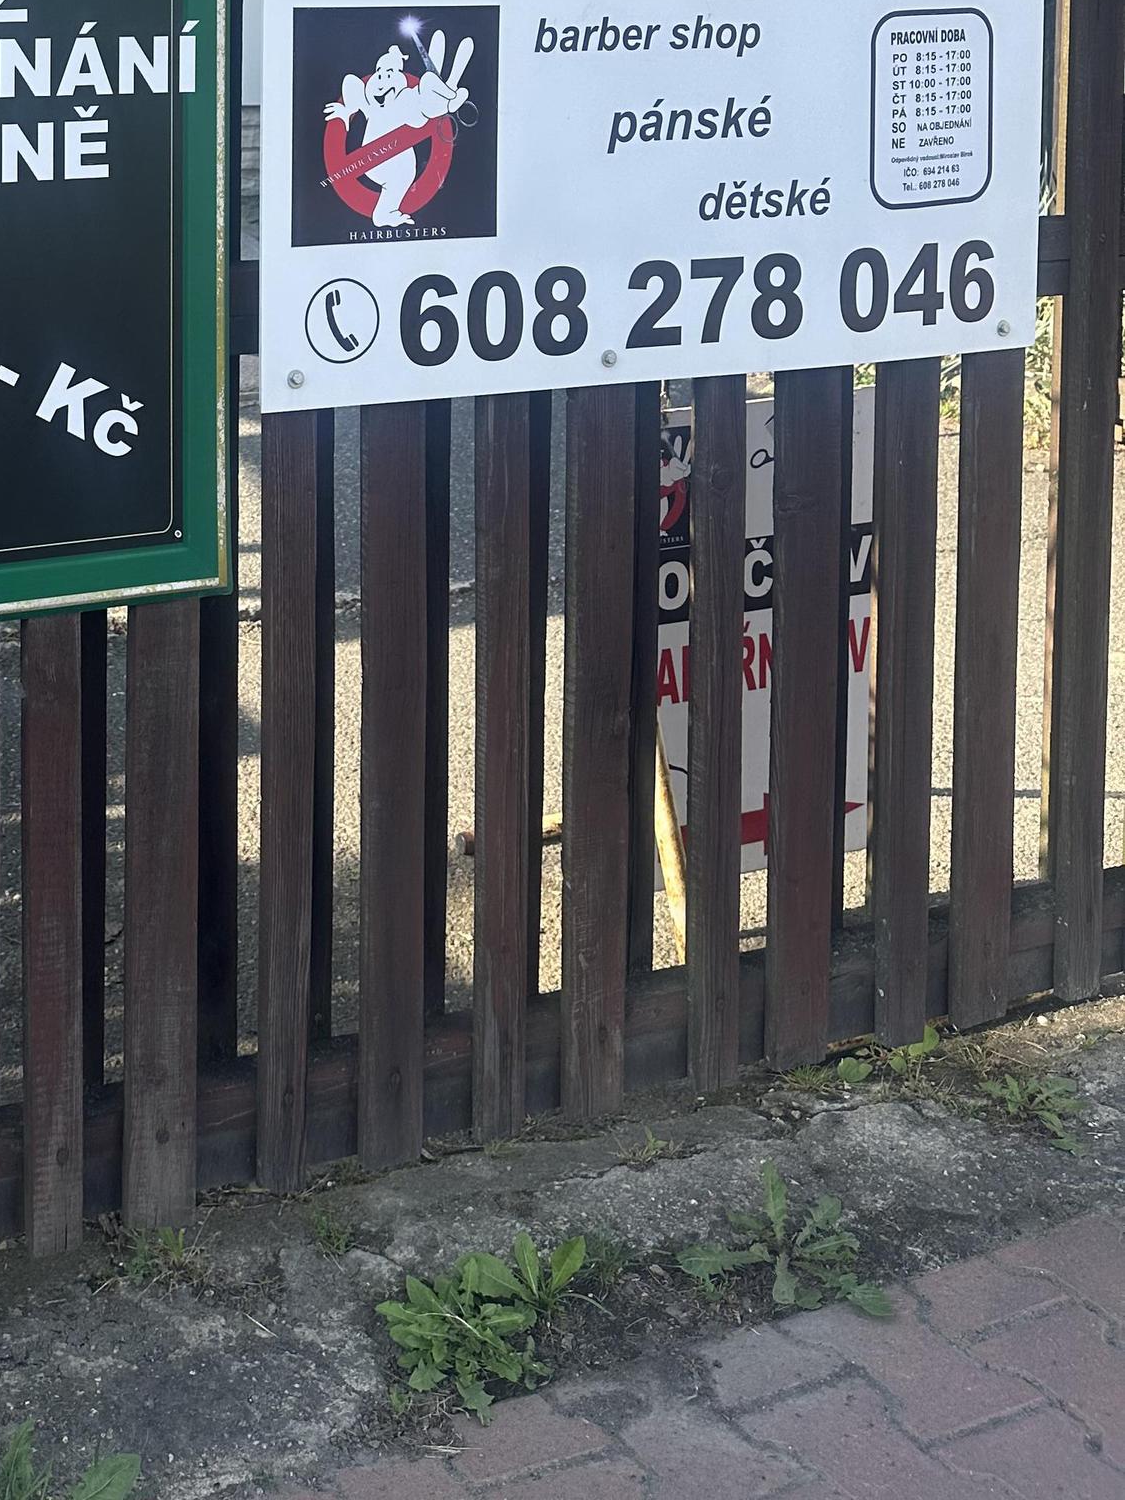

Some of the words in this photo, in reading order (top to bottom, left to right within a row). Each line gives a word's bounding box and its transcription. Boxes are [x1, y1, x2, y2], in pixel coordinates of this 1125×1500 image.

[534, 16, 661, 53] barber
[669, 15, 761, 57] shop
[891, 27, 938, 45] PRACOVNÍ
[940, 29, 966, 43] DOBA
[892, 53, 907, 63] PO
[916, 51, 937, 61] 8:15
[945, 49, 971, 60] 17:00
[892, 65, 907, 76] ÚT
[915, 64, 937, 75] 8:15
[945, 62, 971, 73] 17:00
[892, 80, 906, 91] ST
[909, 78, 936, 89] 10:00
[945, 76, 971, 87] 17:00
[892, 92, 906, 104] ČT
[915, 92, 937, 103] 8:15
[945, 89, 972, 100] 17:00
[892, 106, 907, 118] PÁ
[915, 106, 937, 117] 8:15
[945, 103, 971, 115] 17:00
[606, 95, 771, 154] pánské
[891, 122, 906, 133] SO
[917, 122, 928, 132] NA
[929, 117, 972, 131] OBJEDNÁNÍ
[891, 138, 905, 149] NE
[919, 136, 954, 147] ZAVŘENO
[698, 177, 831, 221] dětské
[349, 227, 447, 241] HAIRBUSTERS
[399, 265, 588, 367] 608
[625, 252, 803, 350] 278
[838, 240, 996, 333] 046
[35, 361, 144, 457] Kč
